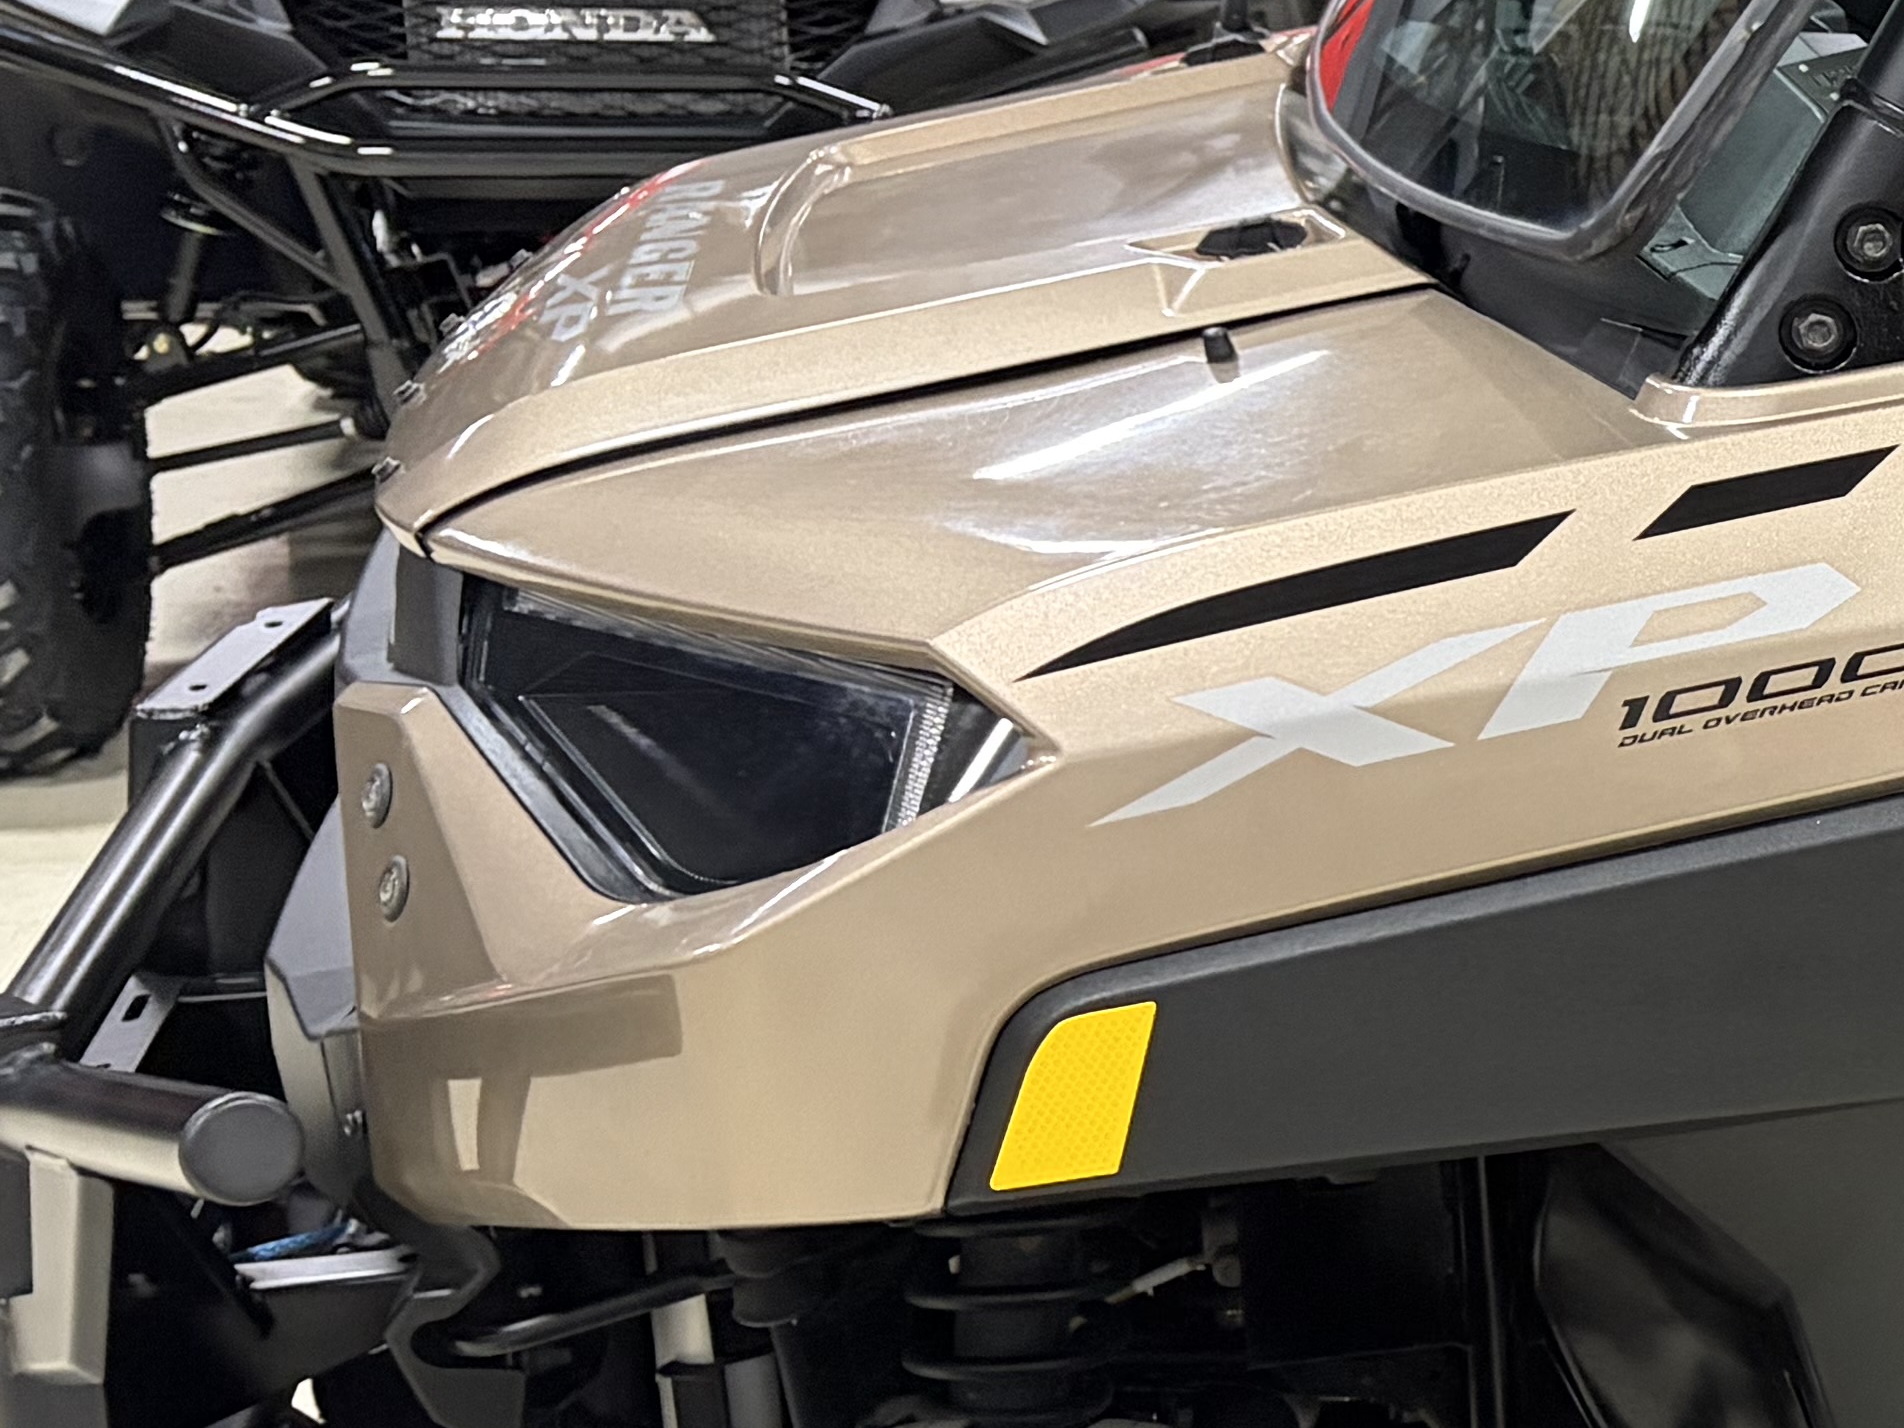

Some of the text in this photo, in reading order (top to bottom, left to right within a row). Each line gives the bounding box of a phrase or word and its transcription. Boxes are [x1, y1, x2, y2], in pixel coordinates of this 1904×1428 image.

[435, 6, 716, 43] HONDA
[606, 179, 725, 315] RANGER
[539, 262, 599, 343] XP
[1089, 562, 1860, 827] XP
[1618, 721, 1693, 749] DUAL
[1702, 689, 1853, 732] OVERHEAD
